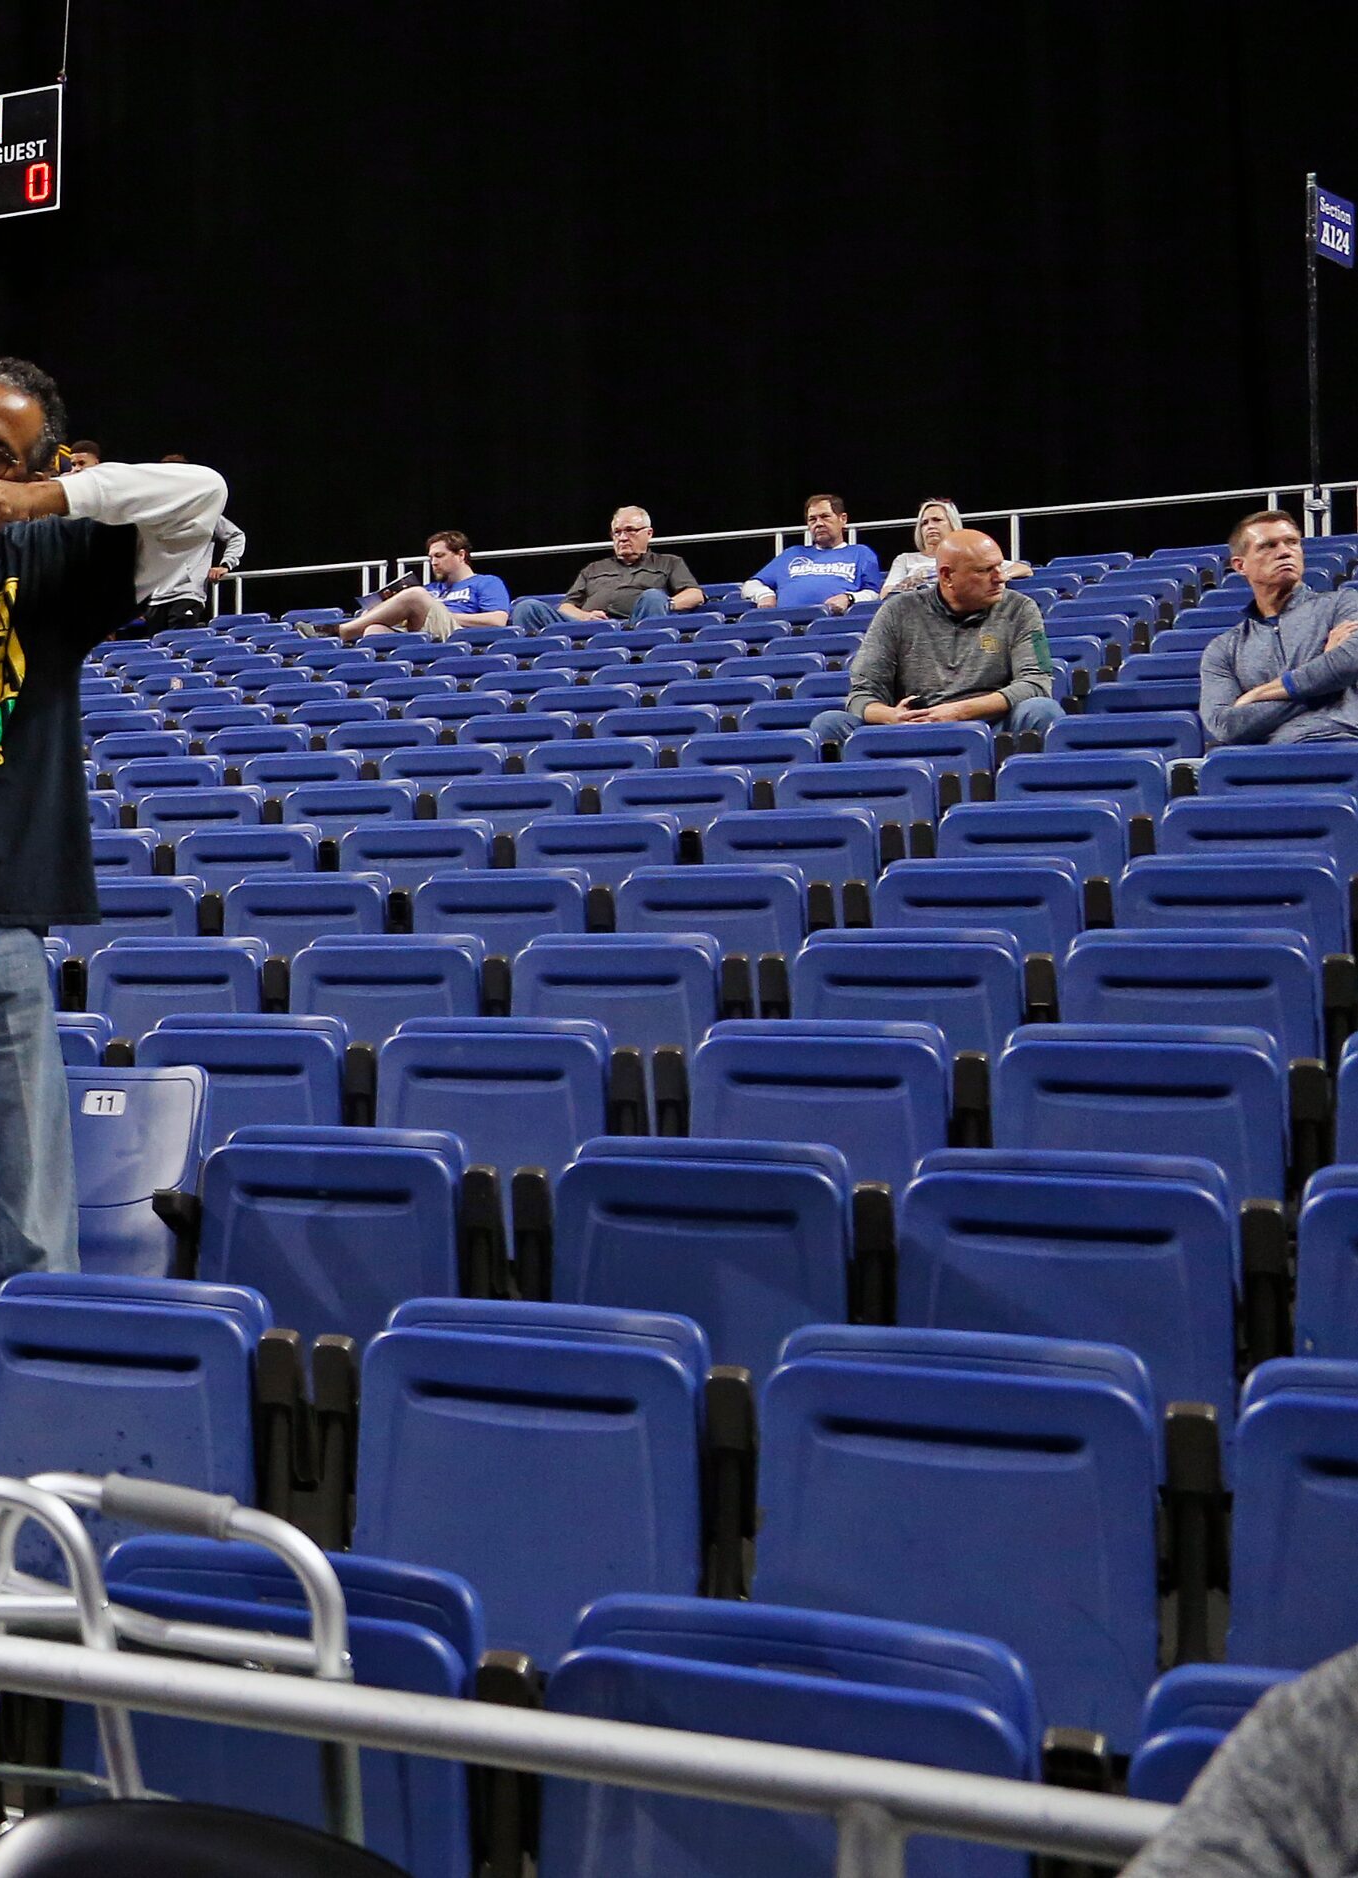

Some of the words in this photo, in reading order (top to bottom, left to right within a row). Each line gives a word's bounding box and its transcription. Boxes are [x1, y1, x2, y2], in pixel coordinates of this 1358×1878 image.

[28, 162, 49, 201] 0
[1318, 196, 1353, 226] Section
[1320, 221, 1351, 256] A124
[96, 1095, 114, 1112] 11
